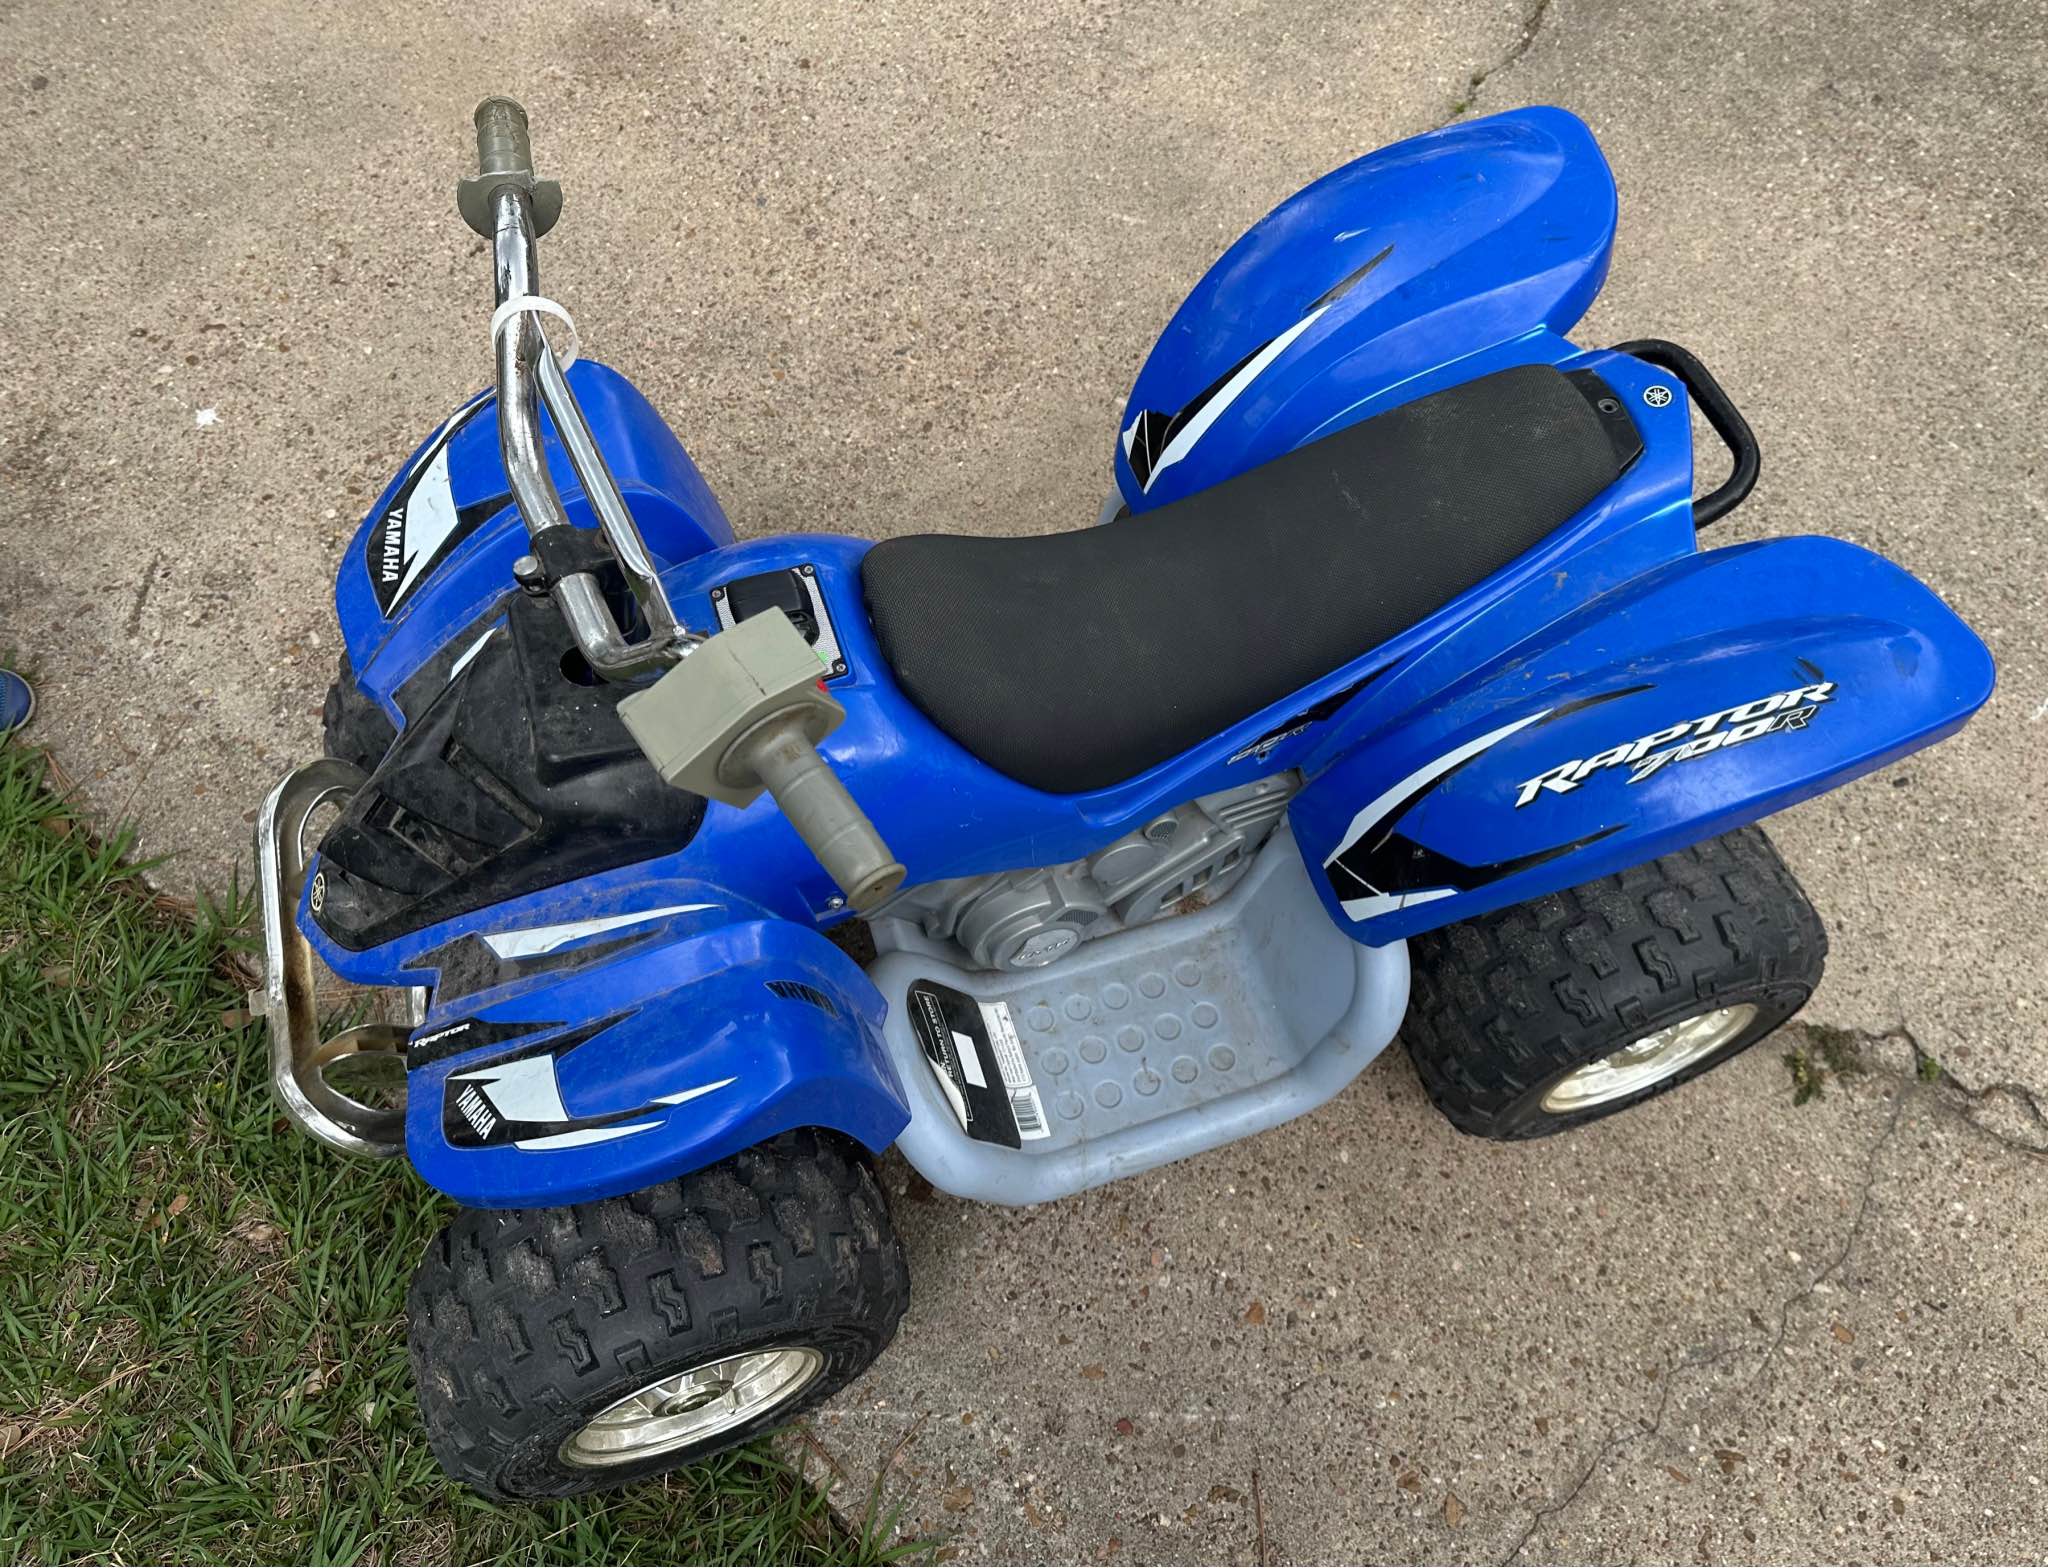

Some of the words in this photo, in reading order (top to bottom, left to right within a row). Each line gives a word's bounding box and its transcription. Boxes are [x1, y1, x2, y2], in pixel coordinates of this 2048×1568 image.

[382, 507, 404, 583] YAMAHA
[1515, 681, 1837, 808] RAPTOR
[1626, 704, 1819, 785] 700R
[414, 1023, 471, 1049] RAPTOR
[455, 1083, 497, 1140] YAMAHA
